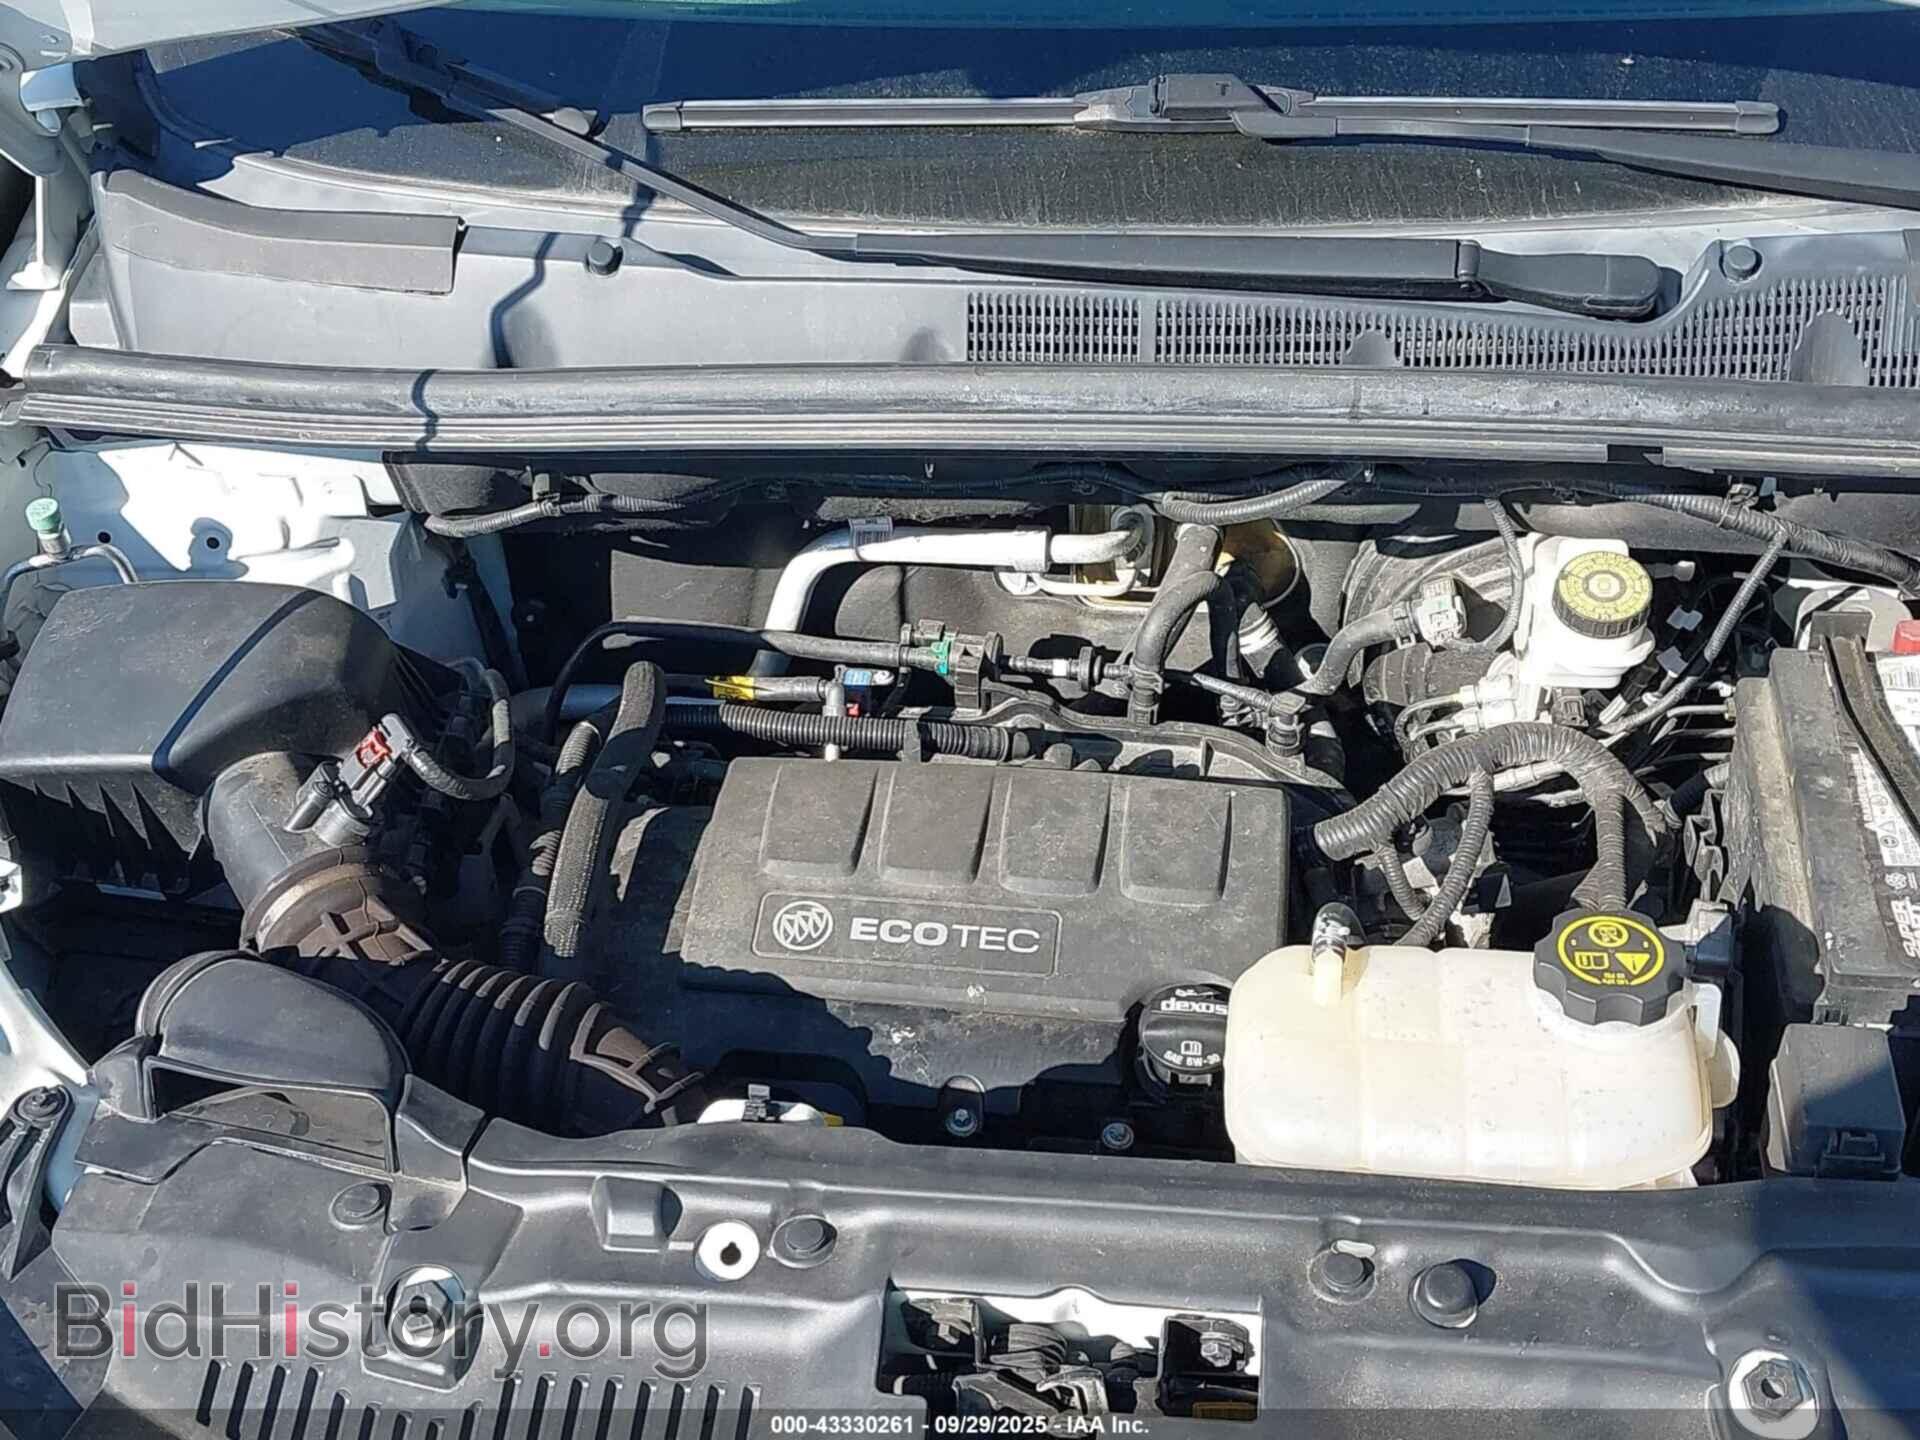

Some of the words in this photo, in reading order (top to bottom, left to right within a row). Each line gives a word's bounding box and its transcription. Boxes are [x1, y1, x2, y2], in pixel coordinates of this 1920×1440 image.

[850, 917, 1041, 953] ECOTEC
[1891, 898, 1917, 958] SUPER
[1160, 997, 1228, 1015] dexos
